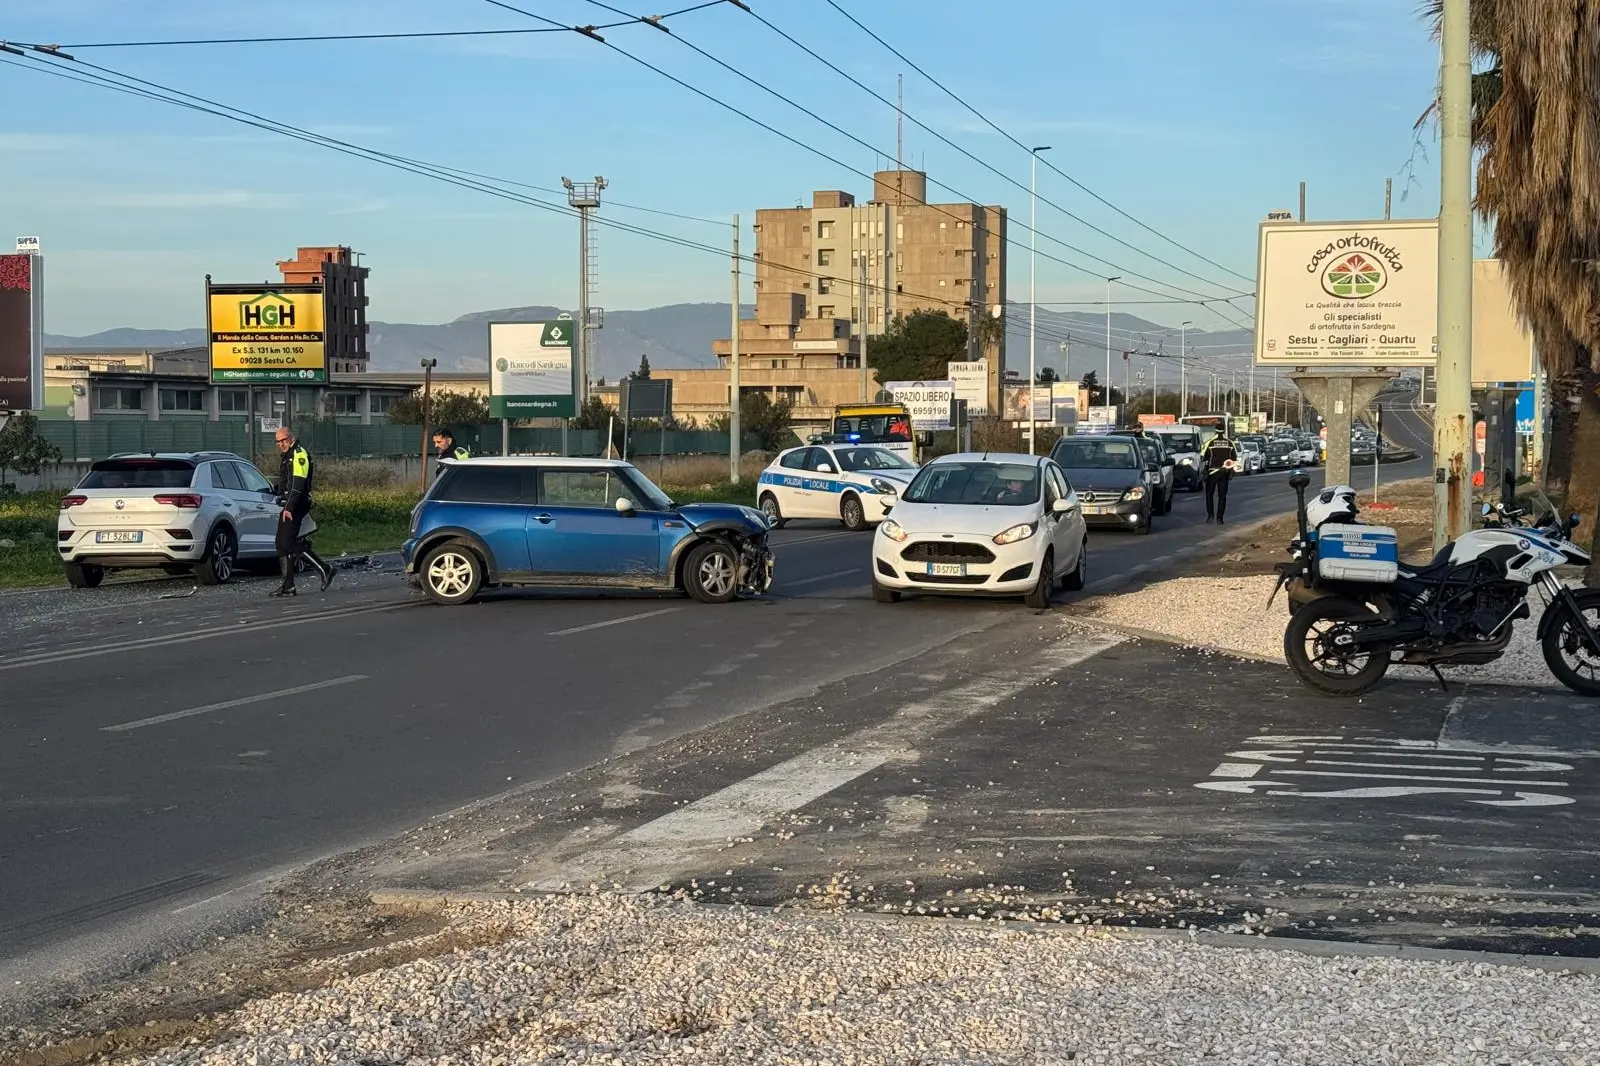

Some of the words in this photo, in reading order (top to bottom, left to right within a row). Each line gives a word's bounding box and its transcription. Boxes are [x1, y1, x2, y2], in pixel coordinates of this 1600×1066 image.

[1306, 242, 1336, 274] casa
[1336, 232, 1404, 272] ortofrutta
[244, 304, 295, 326] HGH
[1324, 312, 1336, 321] Gli
[1337, 312, 1382, 322] specialisti
[1362, 323, 1396, 331] Sardegna
[1288, 335, 1318, 344] Sestu
[1328, 334, 1368, 346] Cagliari
[1379, 334, 1416, 344] Quartu
[537, 360, 567, 369] Sardegna
[895, 392, 920, 402] SPAZIO
[922, 392, 950, 402] LIBERO
[784, 477, 801, 486] POLIZIA
[810, 481, 830, 490] LOCALE
